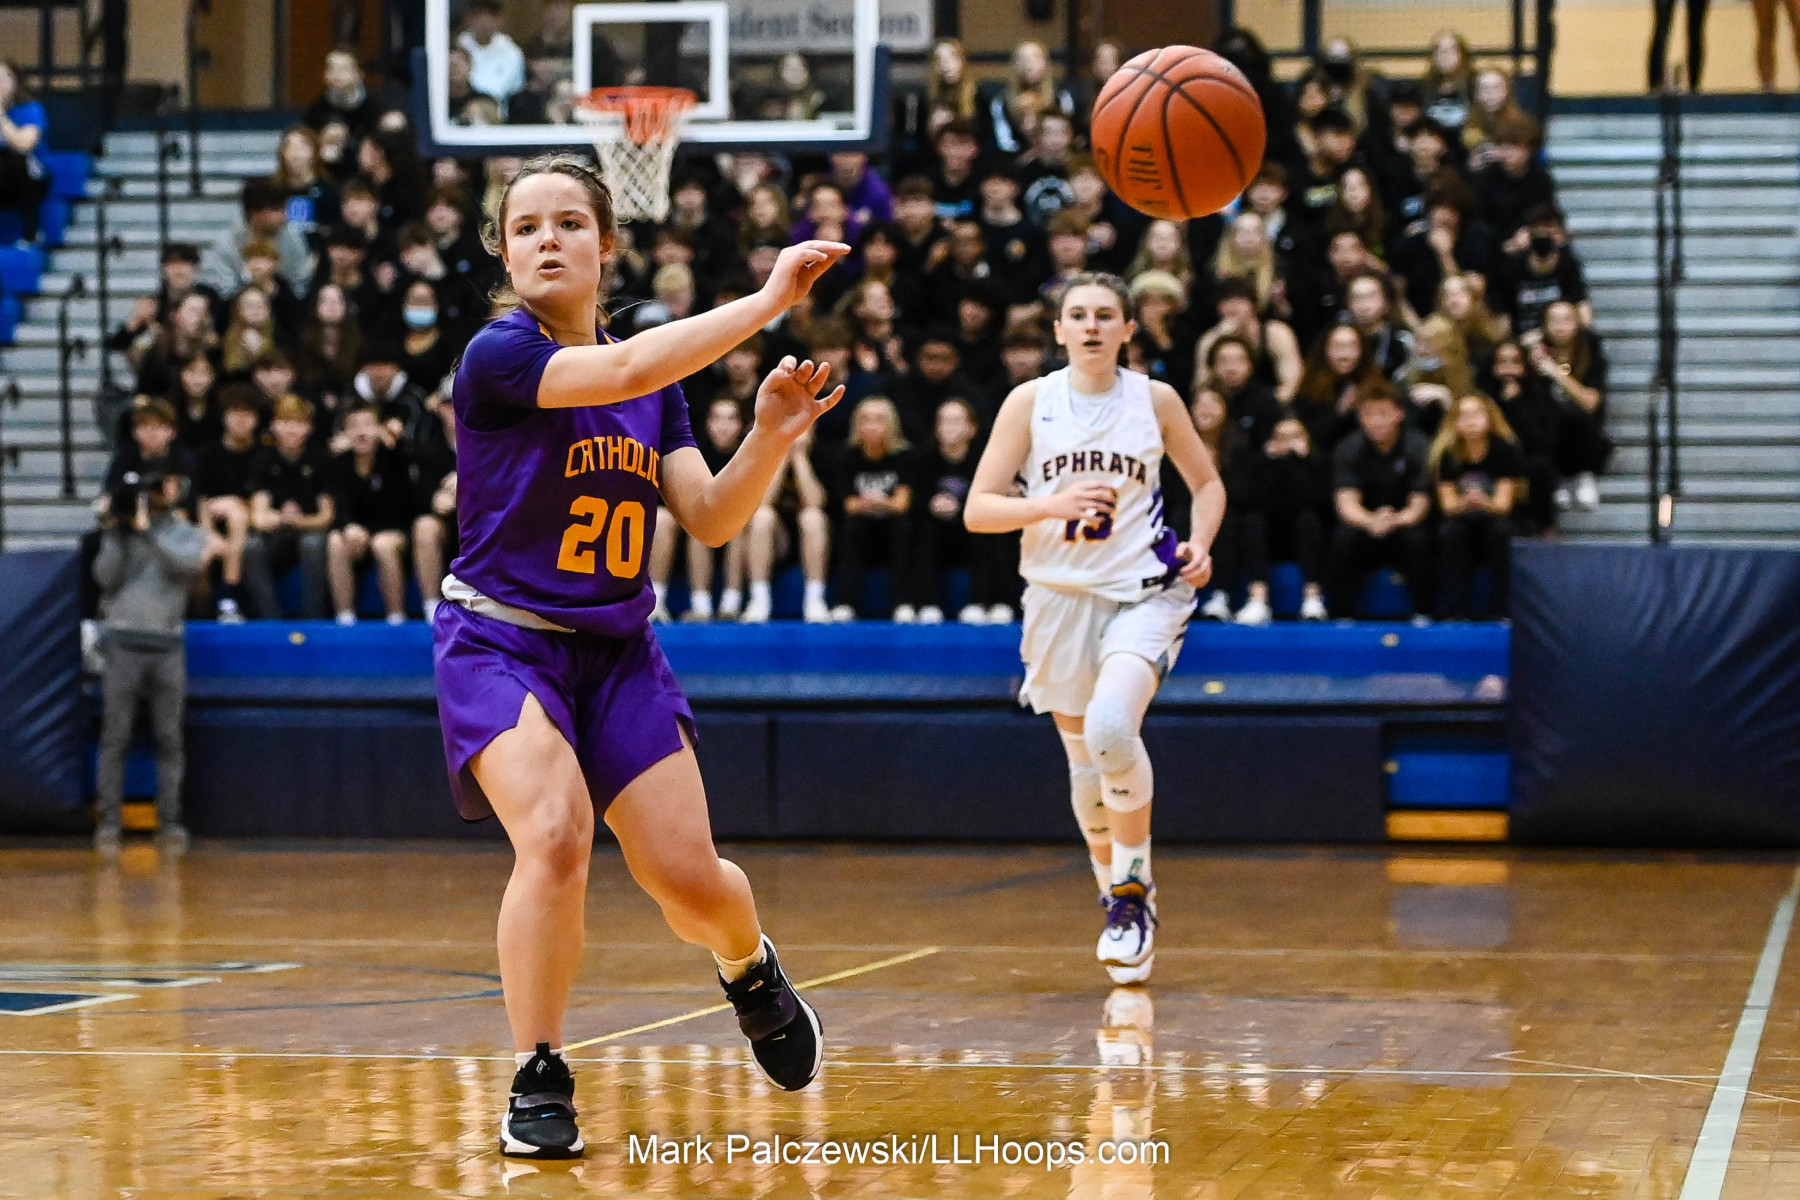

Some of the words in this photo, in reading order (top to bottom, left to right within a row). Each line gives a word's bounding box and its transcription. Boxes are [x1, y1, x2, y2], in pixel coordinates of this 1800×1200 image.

[564, 435, 660, 489] CATHOLIC
[1042, 451, 1147, 484] EPHRATA
[556, 495, 646, 579] 20
